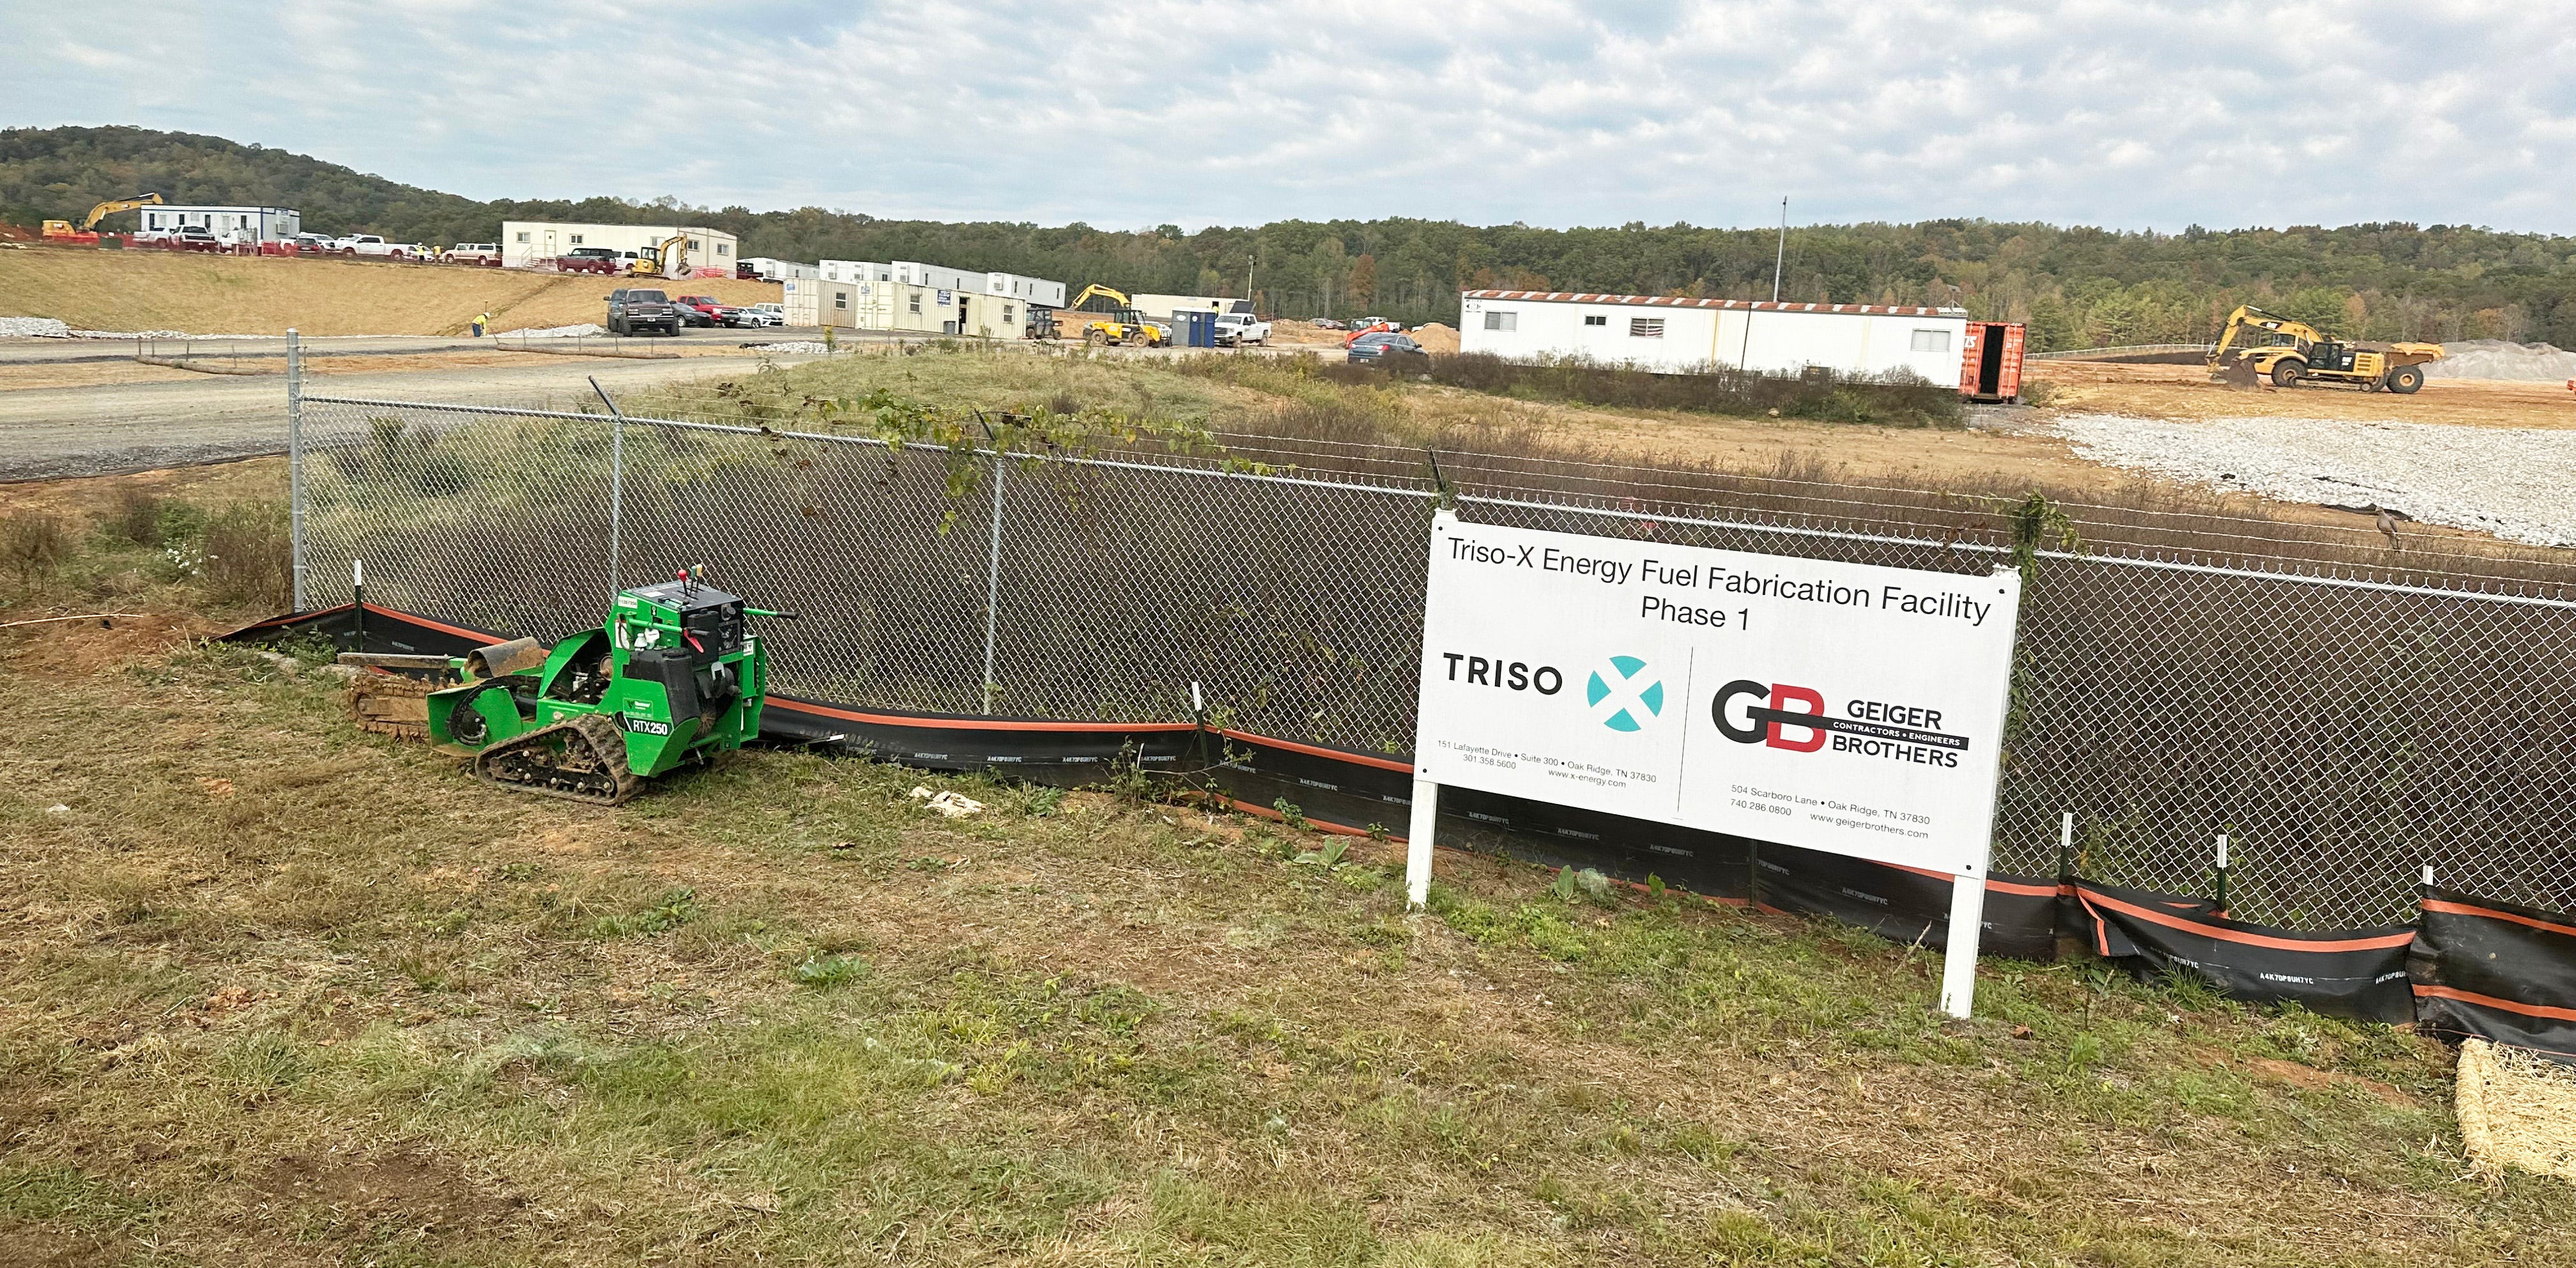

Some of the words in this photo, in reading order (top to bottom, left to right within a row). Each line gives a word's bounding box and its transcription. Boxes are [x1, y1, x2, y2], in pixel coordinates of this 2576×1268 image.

[1448, 537, 1535, 568] Triso-X
[1543, 548, 1633, 585] Energy
[1642, 559, 1698, 587] Fuel
[1708, 566, 1869, 607] Fabrication
[1882, 585, 1991, 627] Facility
[1641, 596, 1726, 628] Phase
[1738, 608, 1748, 631] 1
[1443, 652, 1563, 695] TRISO
[633, 720, 668, 735] RTX250
[1712, 679, 1827, 753] GB
[1847, 699, 1942, 731] GEIGER
[1832, 734, 1958, 768] BROTHERS
[1833, 722, 1900, 738] CONTRACTORS
[1908, 732, 1960, 746] ENGINEERS
[1438, 739, 1450, 748] 151
[1453, 742, 1490, 755] Lafayette
[1491, 748, 1512, 759] Drive
[1521, 753, 1542, 763] Suite
[1543, 757, 1559, 766] 300
[1567, 761, 1584, 771] Oak
[1616, 768, 1628, 778] TN
[1630, 771, 1657, 783] 37830
[1731, 784, 1748, 794] 504
[1751, 787, 1792, 802] Scarboro
[1795, 794, 1818, 806] Lane
[1828, 800, 1847, 811] Oak
[1850, 803, 1880, 817] Ridge,
[1883, 809, 1897, 819] TN
[1899, 812, 1930, 825] 37830
[1810, 812, 1930, 839] www.geigerbrothers.com
